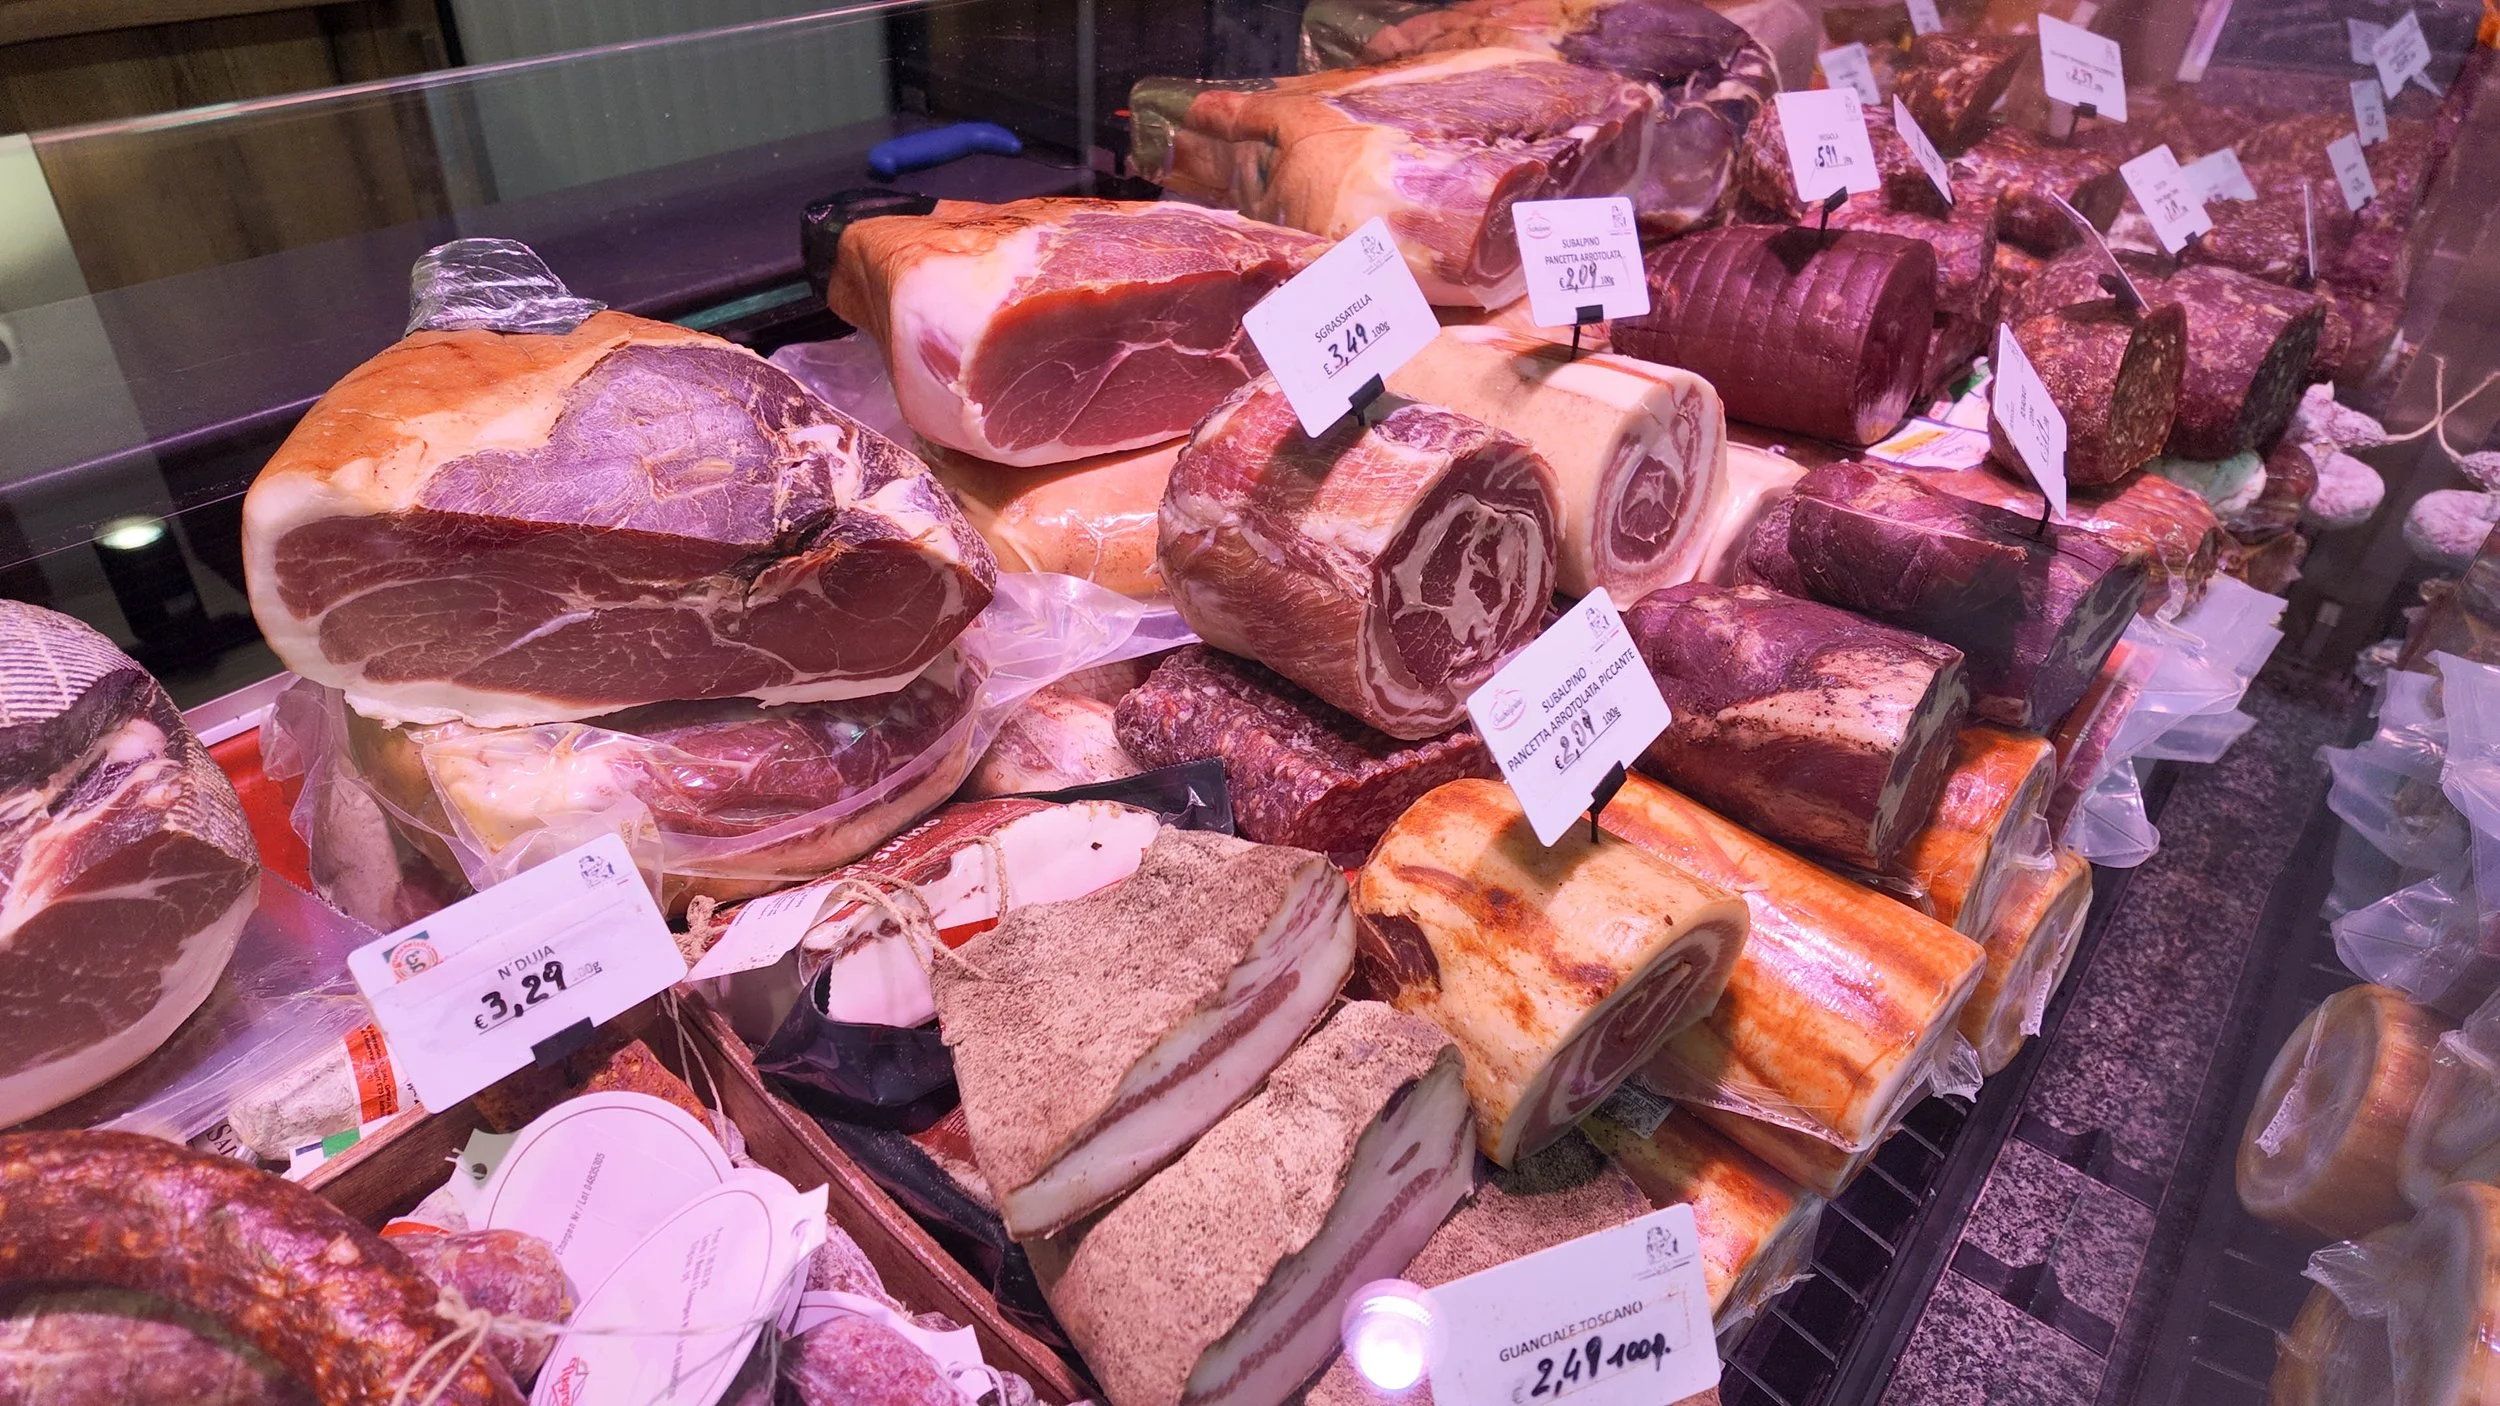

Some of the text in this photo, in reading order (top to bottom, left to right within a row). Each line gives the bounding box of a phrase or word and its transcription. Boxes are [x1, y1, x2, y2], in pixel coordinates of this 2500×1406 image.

[1545, 253, 1579, 265] PANCETTA
[1562, 237, 1600, 249] SUBALPINO
[1314, 293, 1373, 343] SGRASSATELLA
[1371, 320, 1391, 338] 100g
[1541, 666, 1588, 714] SUBALPINO
[1507, 727, 1552, 772] PANCETTA
[1550, 681, 1601, 734] ARROTOLATA
[1598, 647, 1635, 687] PICCANTE
[1602, 706, 1622, 726] 100g
[1499, 1300, 1644, 1362] GUANCIALE TOSCANO
